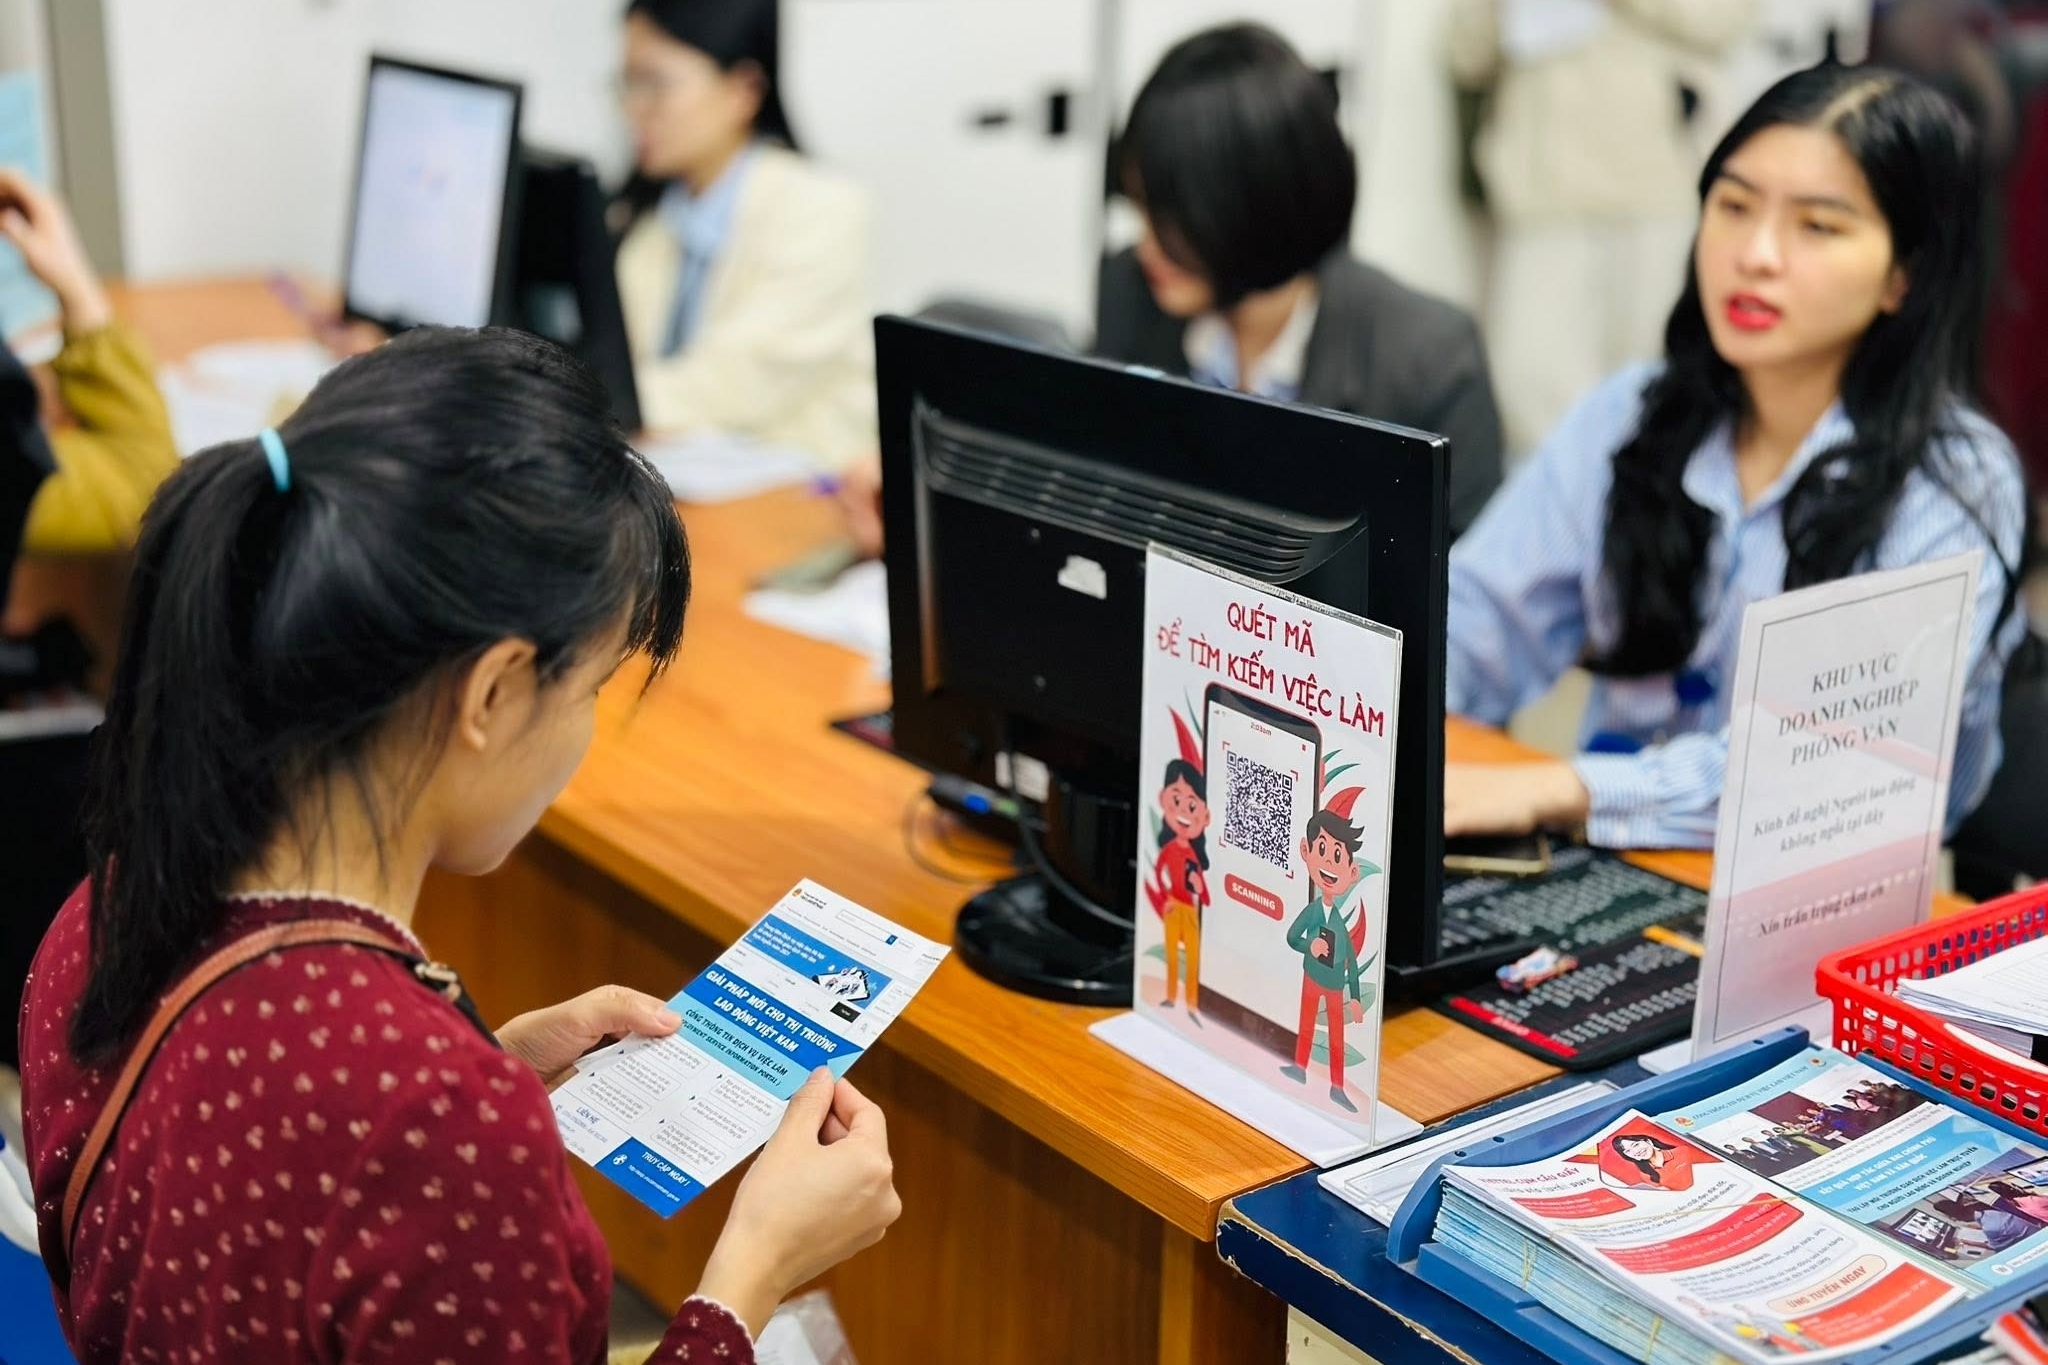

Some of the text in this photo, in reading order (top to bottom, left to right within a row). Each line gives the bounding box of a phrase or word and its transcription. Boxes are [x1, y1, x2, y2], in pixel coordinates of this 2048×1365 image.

[1227, 602, 1315, 657] QUÉT MÃ
[1157, 617, 1384, 737] ĐỂ TÌM KIẾM VIỆC LÀM
[1812, 652, 1898, 693] KHU VỰC
[1779, 699, 1846, 736] DOANH
[1231, 880, 1276, 911] SCANNING
[705, 969, 725, 986] GIẢI
[723, 980, 750, 1000] PHÁP
[746, 995, 768, 1012] MỚI
[765, 1006, 786, 1022] CHO
[784, 1016, 803, 1034] THỊ
[800, 1026, 838, 1054] TRƯỜNG
[713, 996, 800, 1053] LAO ĐỘNG VIỆT NAM
[705, 1035, 727, 1052] SERVICE
[725, 1046, 761, 1074] INFORMATION
[721, 1031, 734, 1042] TIN
[731, 1038, 750, 1053] DỊCH
[757, 1052, 774, 1067] VIỆC
[771, 1061, 789, 1077] LÀM
[641, 1151, 660, 1165] TRUY
[668, 1169, 688, 1184] NGAY
[1840, 1265, 1867, 1287] NGAY
